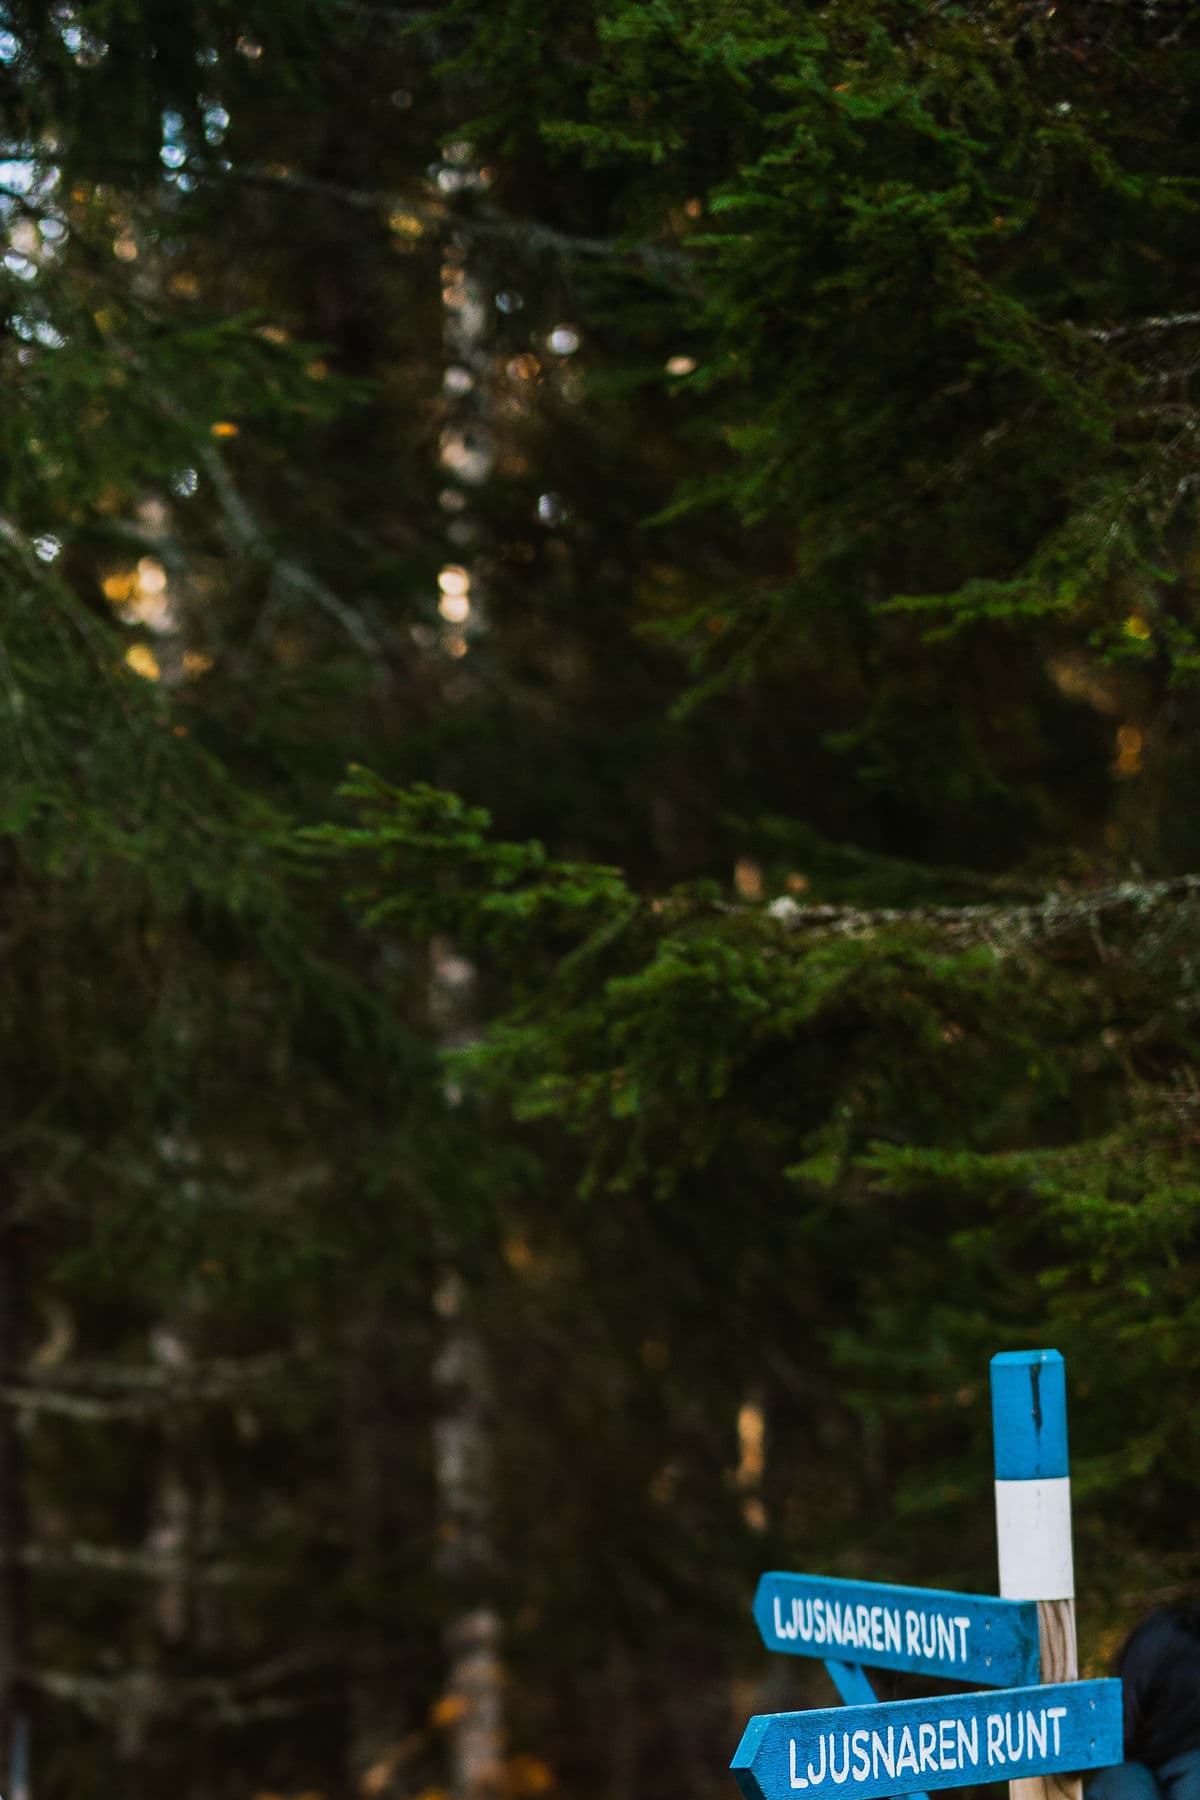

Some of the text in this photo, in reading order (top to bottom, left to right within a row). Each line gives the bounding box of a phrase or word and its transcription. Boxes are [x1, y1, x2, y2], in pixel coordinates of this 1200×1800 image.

[774, 1597, 970, 1662] LJUSNAREN RUNT
[789, 1708, 1067, 1789] LJUSNAREN RUNT
